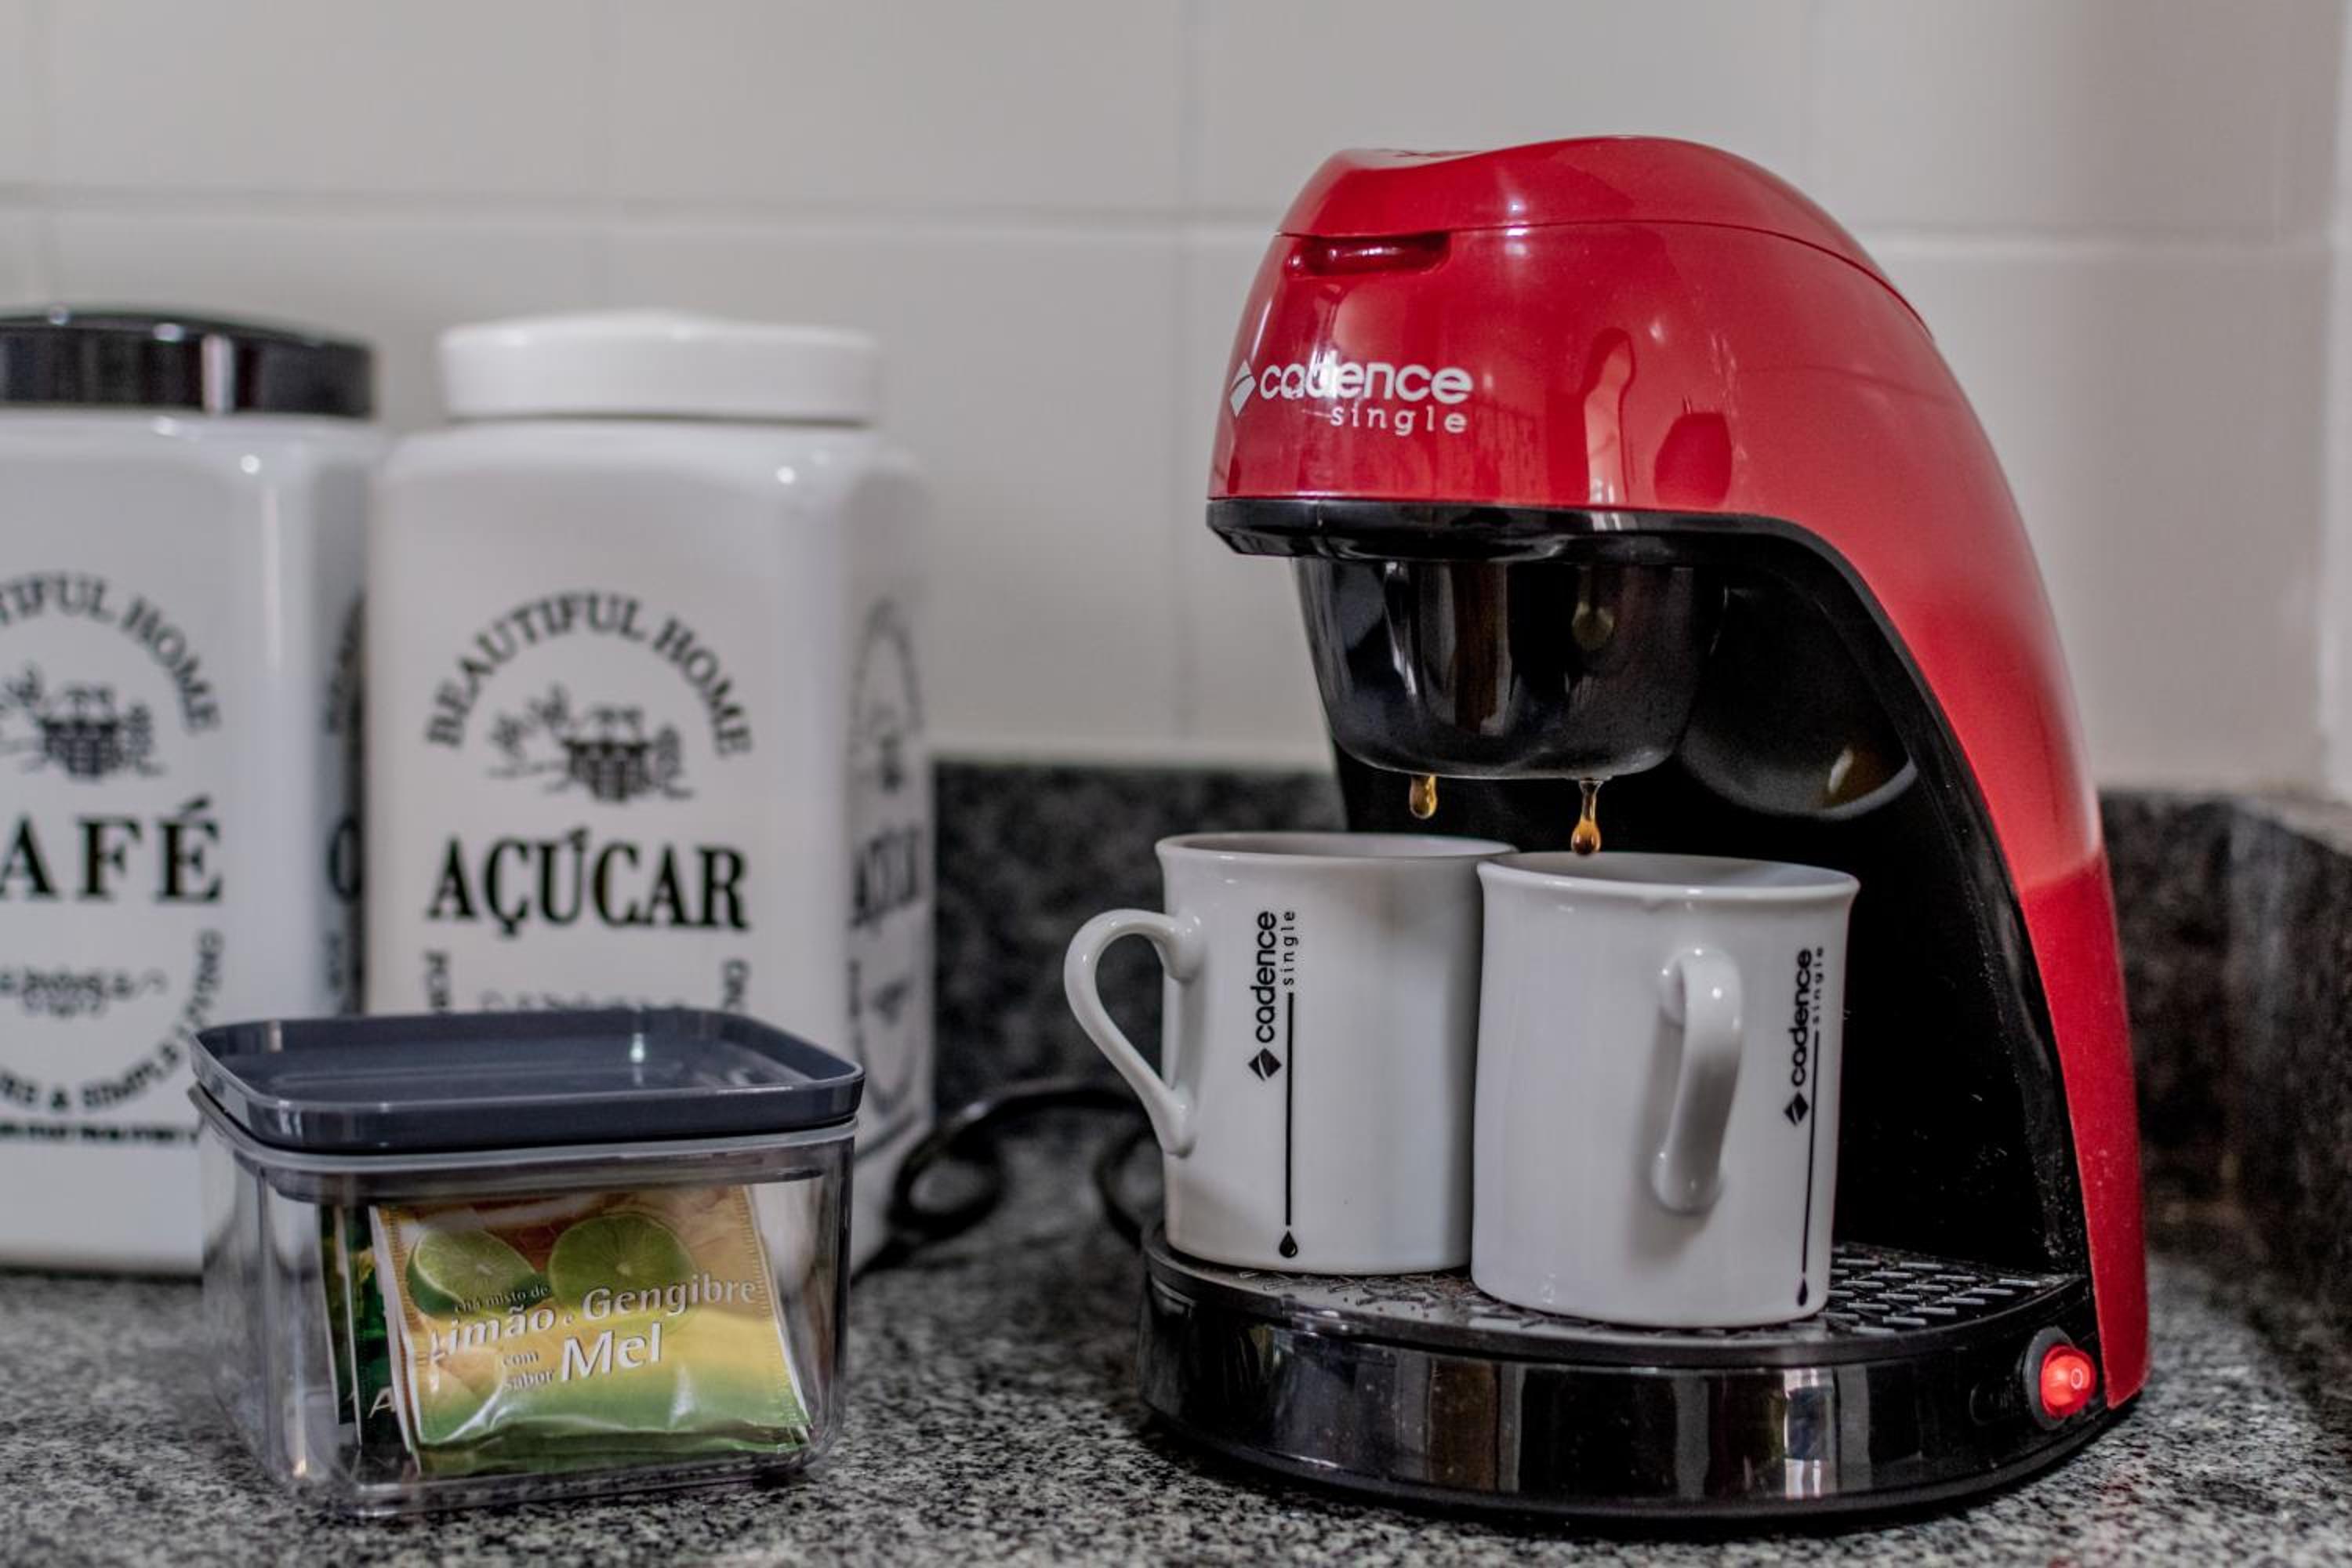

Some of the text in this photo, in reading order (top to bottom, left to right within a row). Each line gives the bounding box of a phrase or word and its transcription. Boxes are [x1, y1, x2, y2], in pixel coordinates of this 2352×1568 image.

[1260, 350, 1473, 405] cadence
[1330, 405, 1468, 437] single
[120, 596, 222, 737] HOME
[426, 592, 648, 749] BEAUTIFUL
[652, 618, 753, 759] HOME
[426, 826, 750, 939] AÇÚCAR
[1250, 910, 1277, 1044] cadence
[1280, 911, 1298, 985] single
[1788, 949, 1812, 1087] cadence
[583, 1273, 757, 1321] Gengibre
[503, 1350, 539, 1367] com
[561, 1321, 662, 1382] Mel
